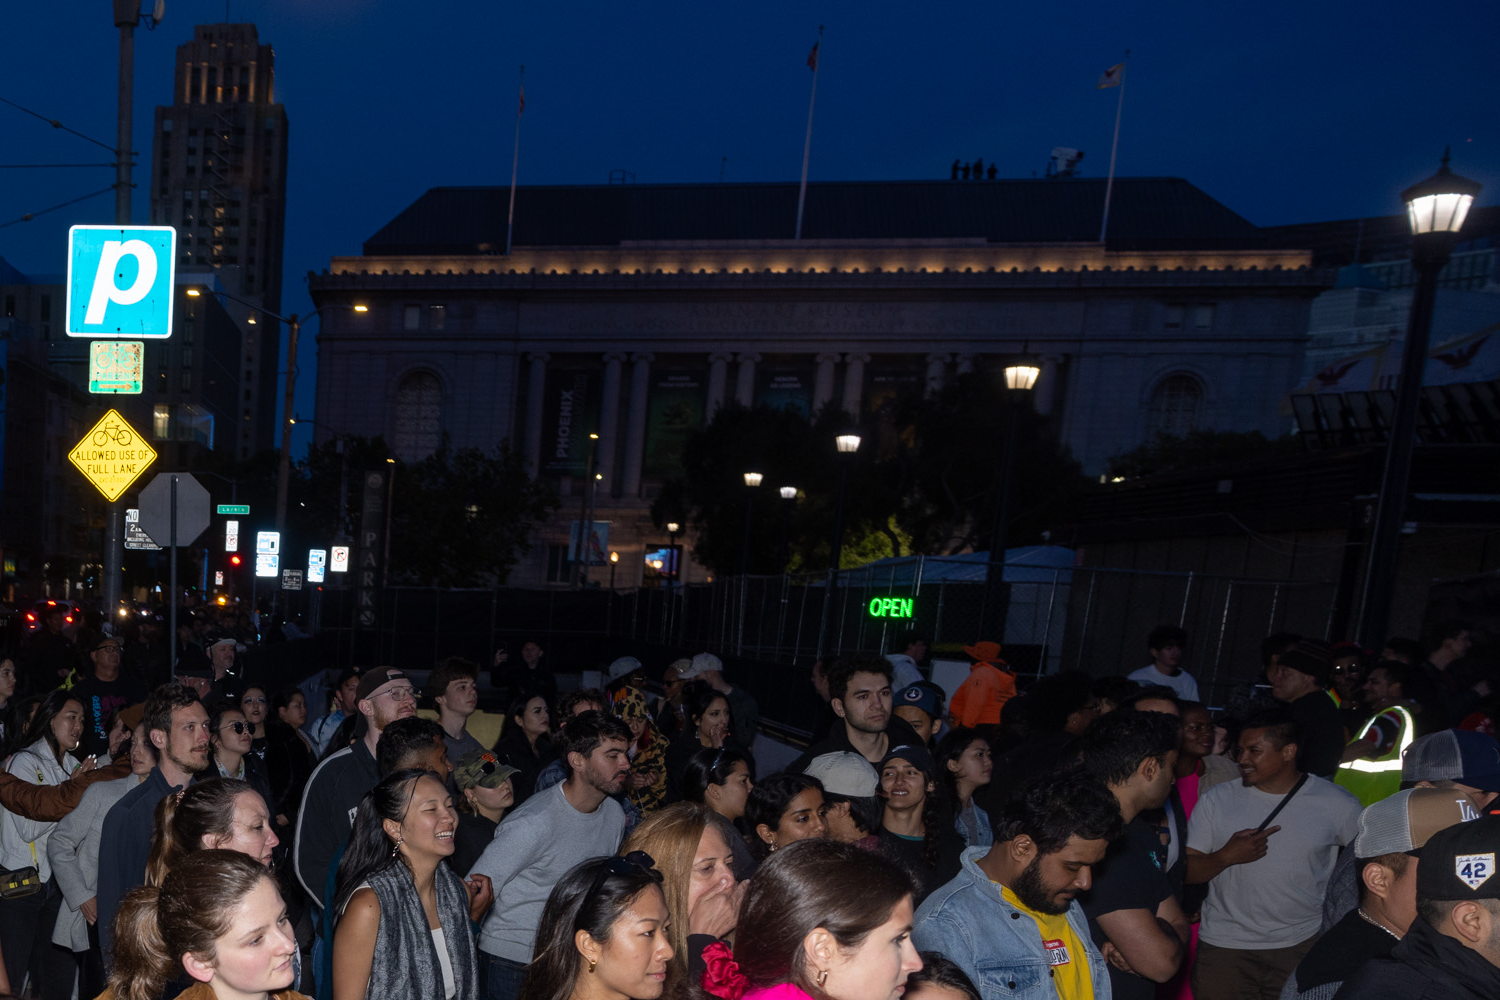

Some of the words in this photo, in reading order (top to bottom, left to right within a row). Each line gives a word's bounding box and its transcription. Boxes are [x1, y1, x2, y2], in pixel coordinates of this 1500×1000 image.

[96, 372, 138, 380] PARKING
[556, 389, 575, 458] PHOENIX
[76, 450, 116, 461] ALLOWED
[119, 450, 135, 460] USE
[138, 450, 148, 460] OF
[87, 464, 109, 474] FULL
[114, 463, 137, 474] LANE
[127, 511, 138, 521] NO
[361, 532, 377, 606] PARK
[869, 597, 914, 618] OPEN
[1461, 862, 1487, 879] 42
